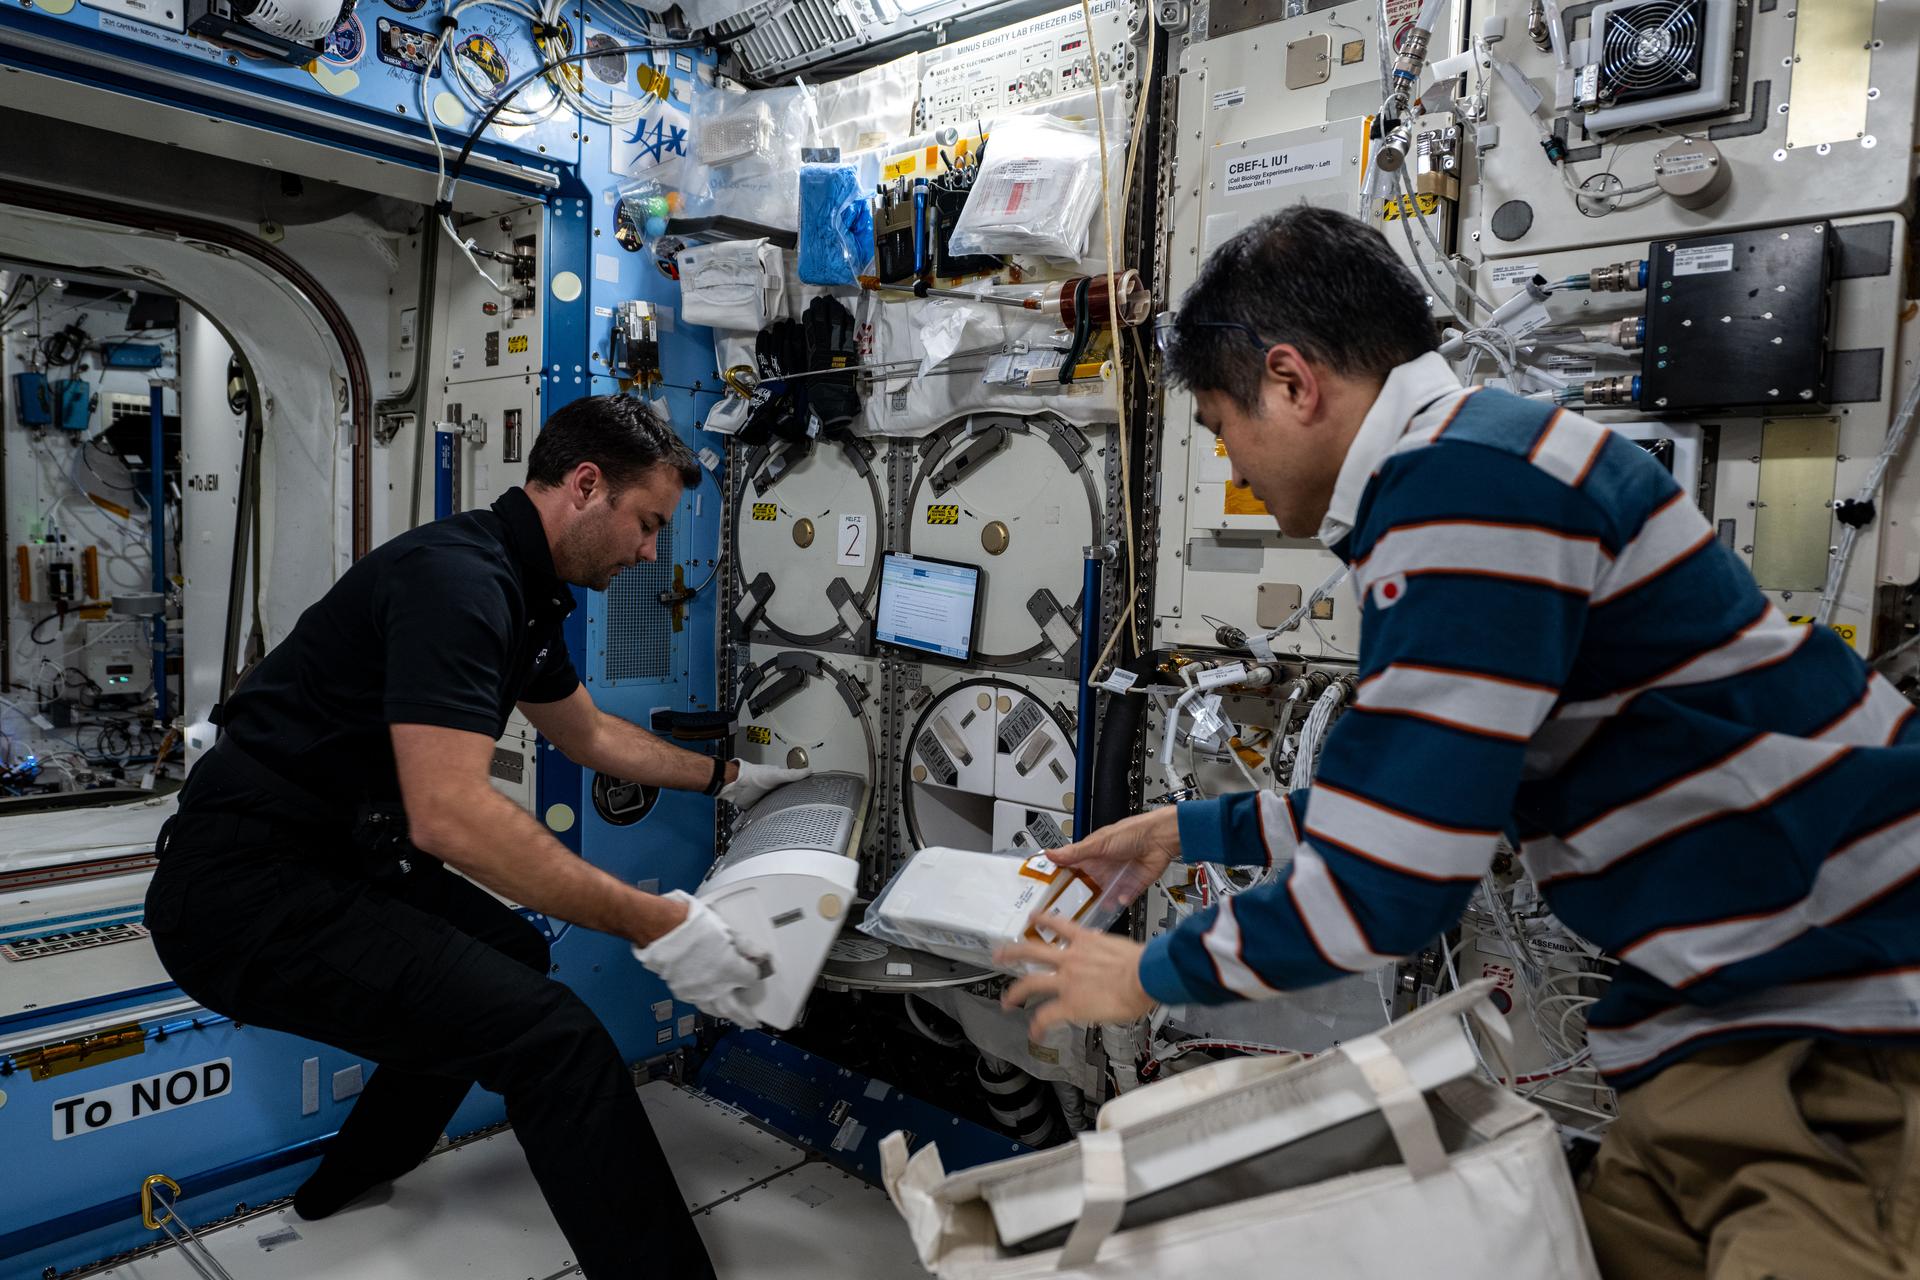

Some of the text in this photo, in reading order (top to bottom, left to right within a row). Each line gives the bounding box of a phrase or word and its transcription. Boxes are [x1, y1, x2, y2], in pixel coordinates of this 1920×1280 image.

[1399, 2, 1417, 11] PORT
[957, 41, 981, 55] MINUS
[982, 33, 1010, 48] EIGHTY
[1012, 27, 1028, 39] LAB
[1029, 15, 1067, 33] FREEZER
[1068, 10, 1083, 21] ISS
[1090, 0, 1116, 15] ELFI)
[966, 55, 996, 68] ELECTRONIC
[620, 115, 688, 168] JAX
[1228, 176, 1241, 185] (Cell
[1241, 173, 1262, 183] Biology
[1262, 167, 1294, 180] Experiment
[1294, 163, 1315, 172] Facility
[1319, 160, 1331, 168] Left
[1229, 154, 1288, 175] CBEF-L IU1
[1227, 178, 1272, 191] Incubator Unit 1)
[194, 473, 219, 491] To JEM
[845, 524, 861, 557] 2
[1531, 938, 1575, 953] ASSEMBLY
[54, 1062, 231, 1135] To NOD
